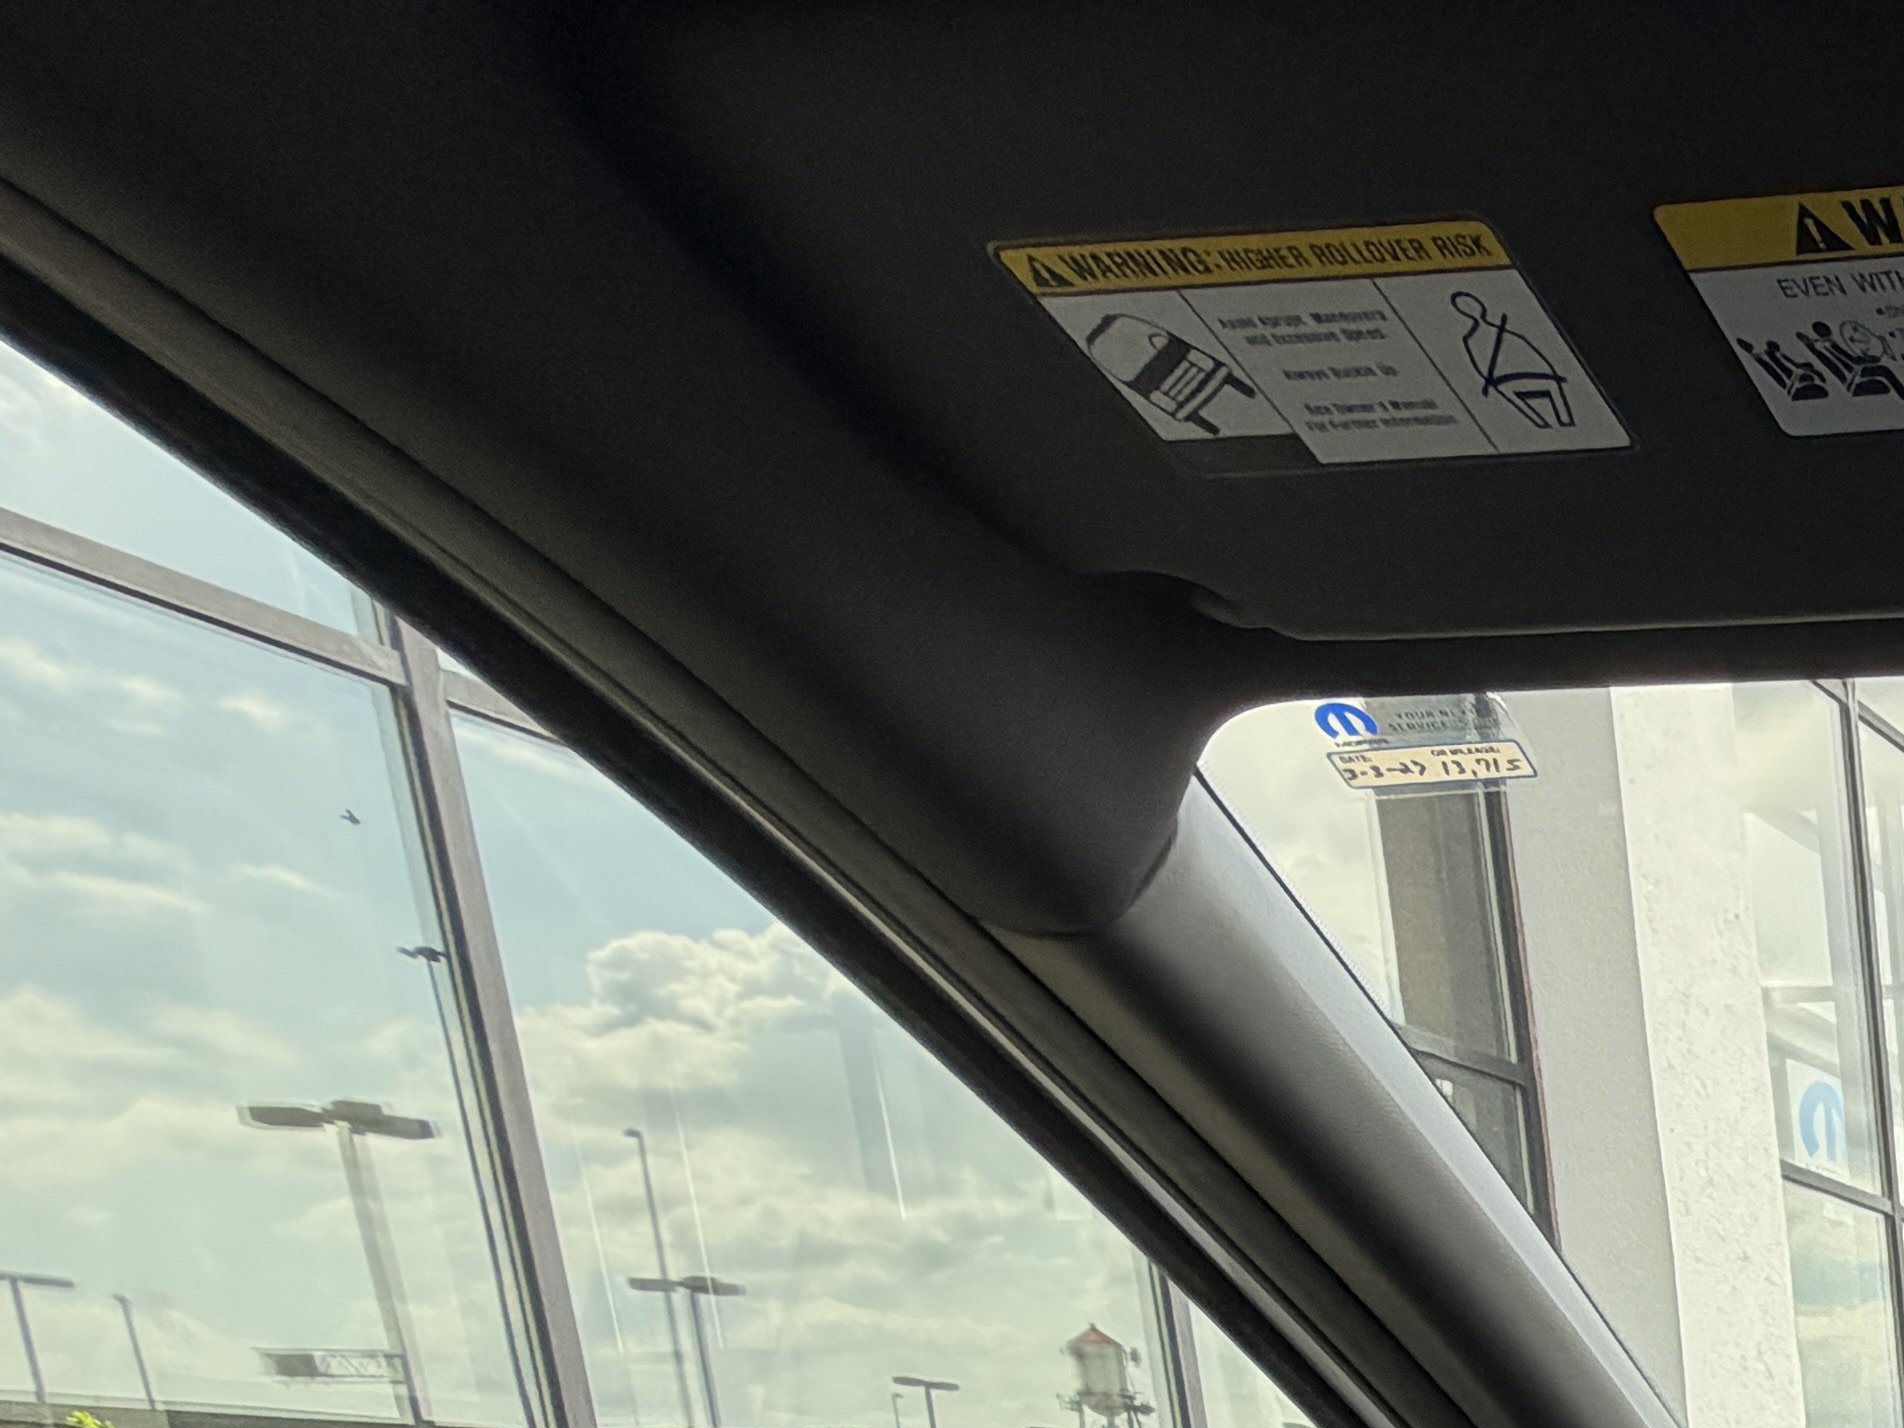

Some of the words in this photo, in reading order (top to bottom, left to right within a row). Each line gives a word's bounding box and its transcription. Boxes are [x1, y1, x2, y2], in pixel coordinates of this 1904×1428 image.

[1217, 244, 1311, 271] HIGHER
[1309, 238, 1432, 267] ROLLOVER
[1431, 233, 1493, 260] RISK
[1777, 275, 1848, 298] EVEN
